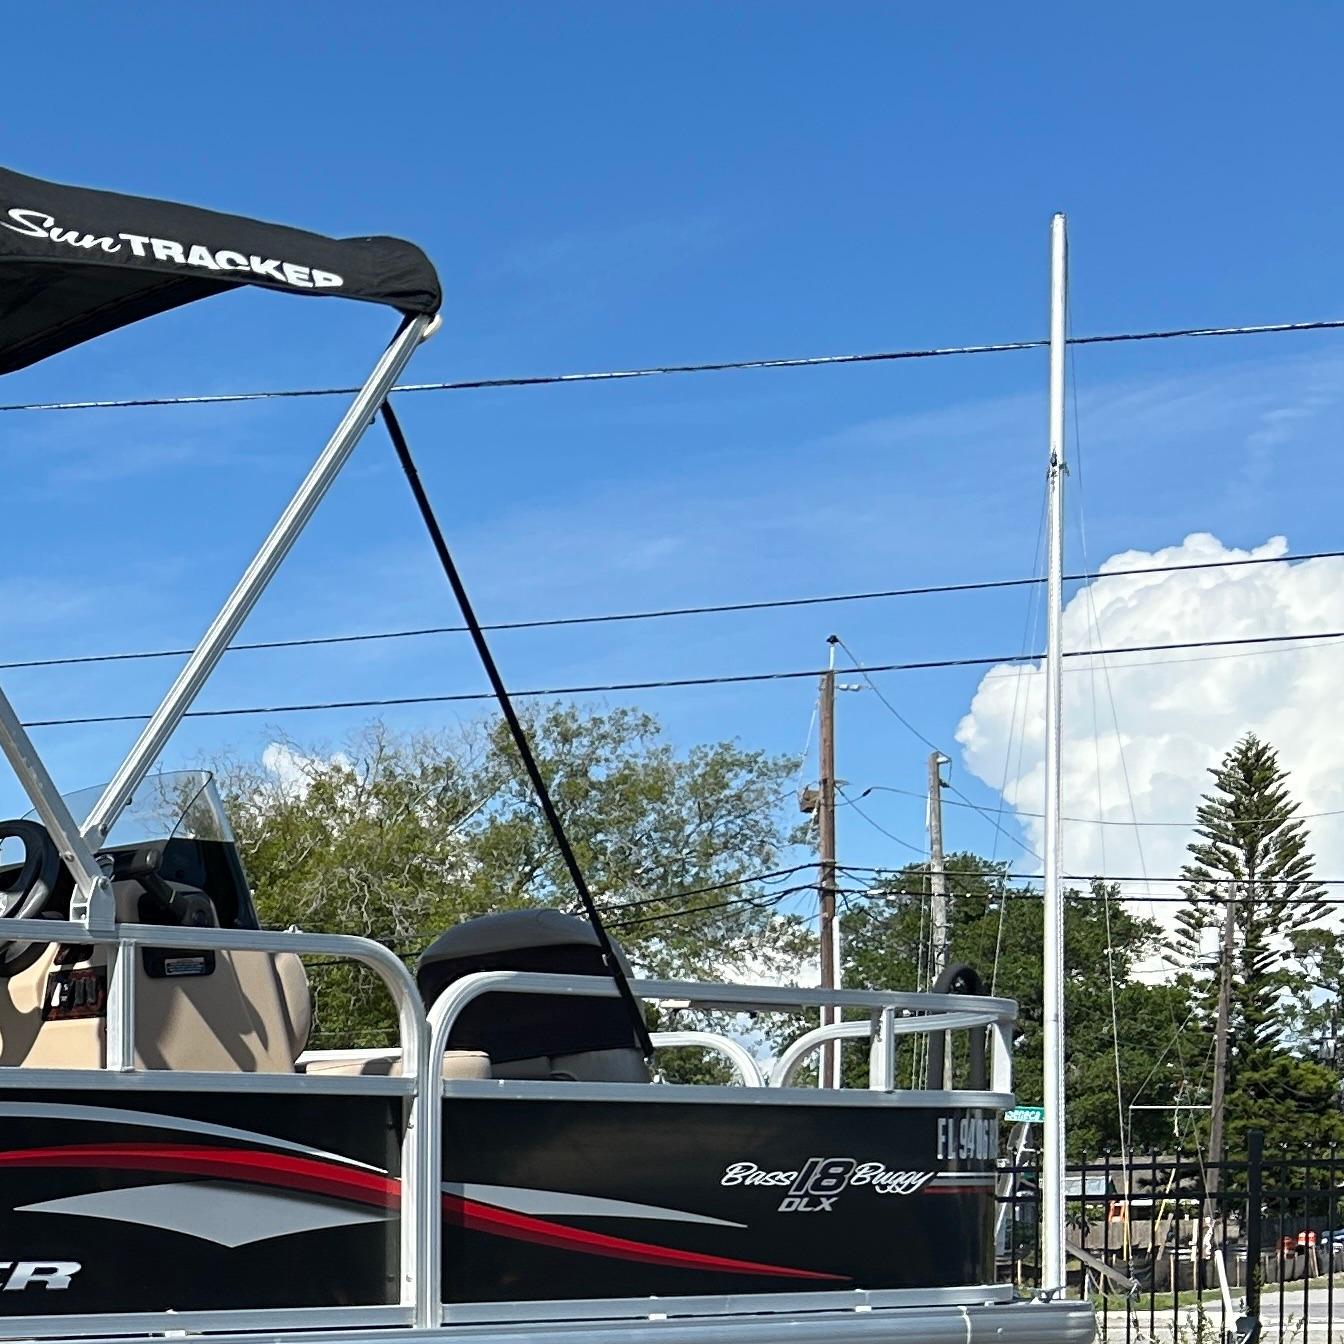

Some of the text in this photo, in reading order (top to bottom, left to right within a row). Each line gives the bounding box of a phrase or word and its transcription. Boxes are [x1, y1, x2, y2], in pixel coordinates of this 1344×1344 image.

[0, 207, 122, 253] Sun
[937, 1117, 956, 1160] FL
[720, 1157, 935, 1195] Bass 18 Buggy
[777, 1197, 839, 1212] DLX
